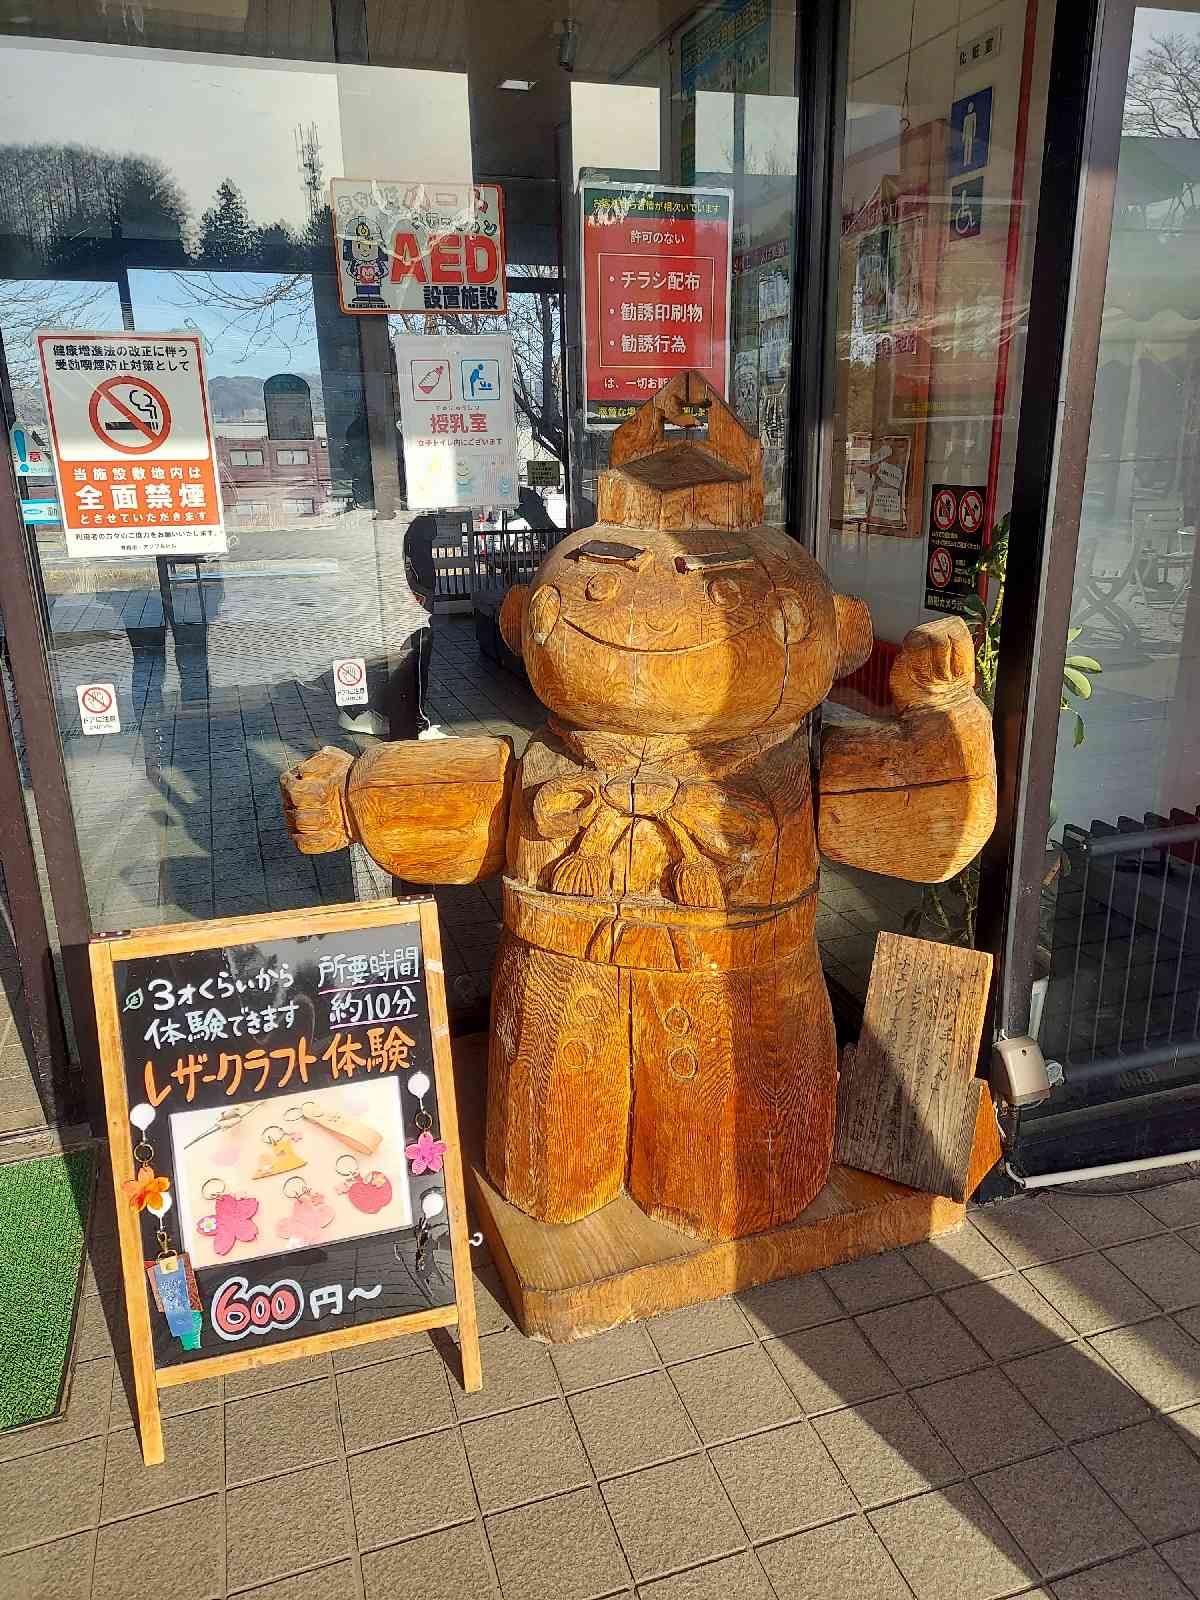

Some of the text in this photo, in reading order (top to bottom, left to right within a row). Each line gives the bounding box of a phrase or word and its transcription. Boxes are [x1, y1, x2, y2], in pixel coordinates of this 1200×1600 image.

[630, 230, 685, 244] 許可のない
[390, 232, 498, 285] AED
[424, 286, 498, 310] 設置施設
[53, 344, 188, 358] 健康増進法の改正に伴う
[55, 359, 190, 372] 受動喫煙防止対策として
[430, 413, 488, 434] 授乳室
[73, 466, 201, 481] 当施設敷地内は
[74, 482, 207, 510] 全面禁煙
[80, 512, 208, 525] とさせていただきます
[318, 946, 419, 988] 所要時間
[148, 963, 294, 1011] 3才くらいから
[330, 985, 416, 1024] 約10分
[144, 1000, 299, 1050] 体験できます
